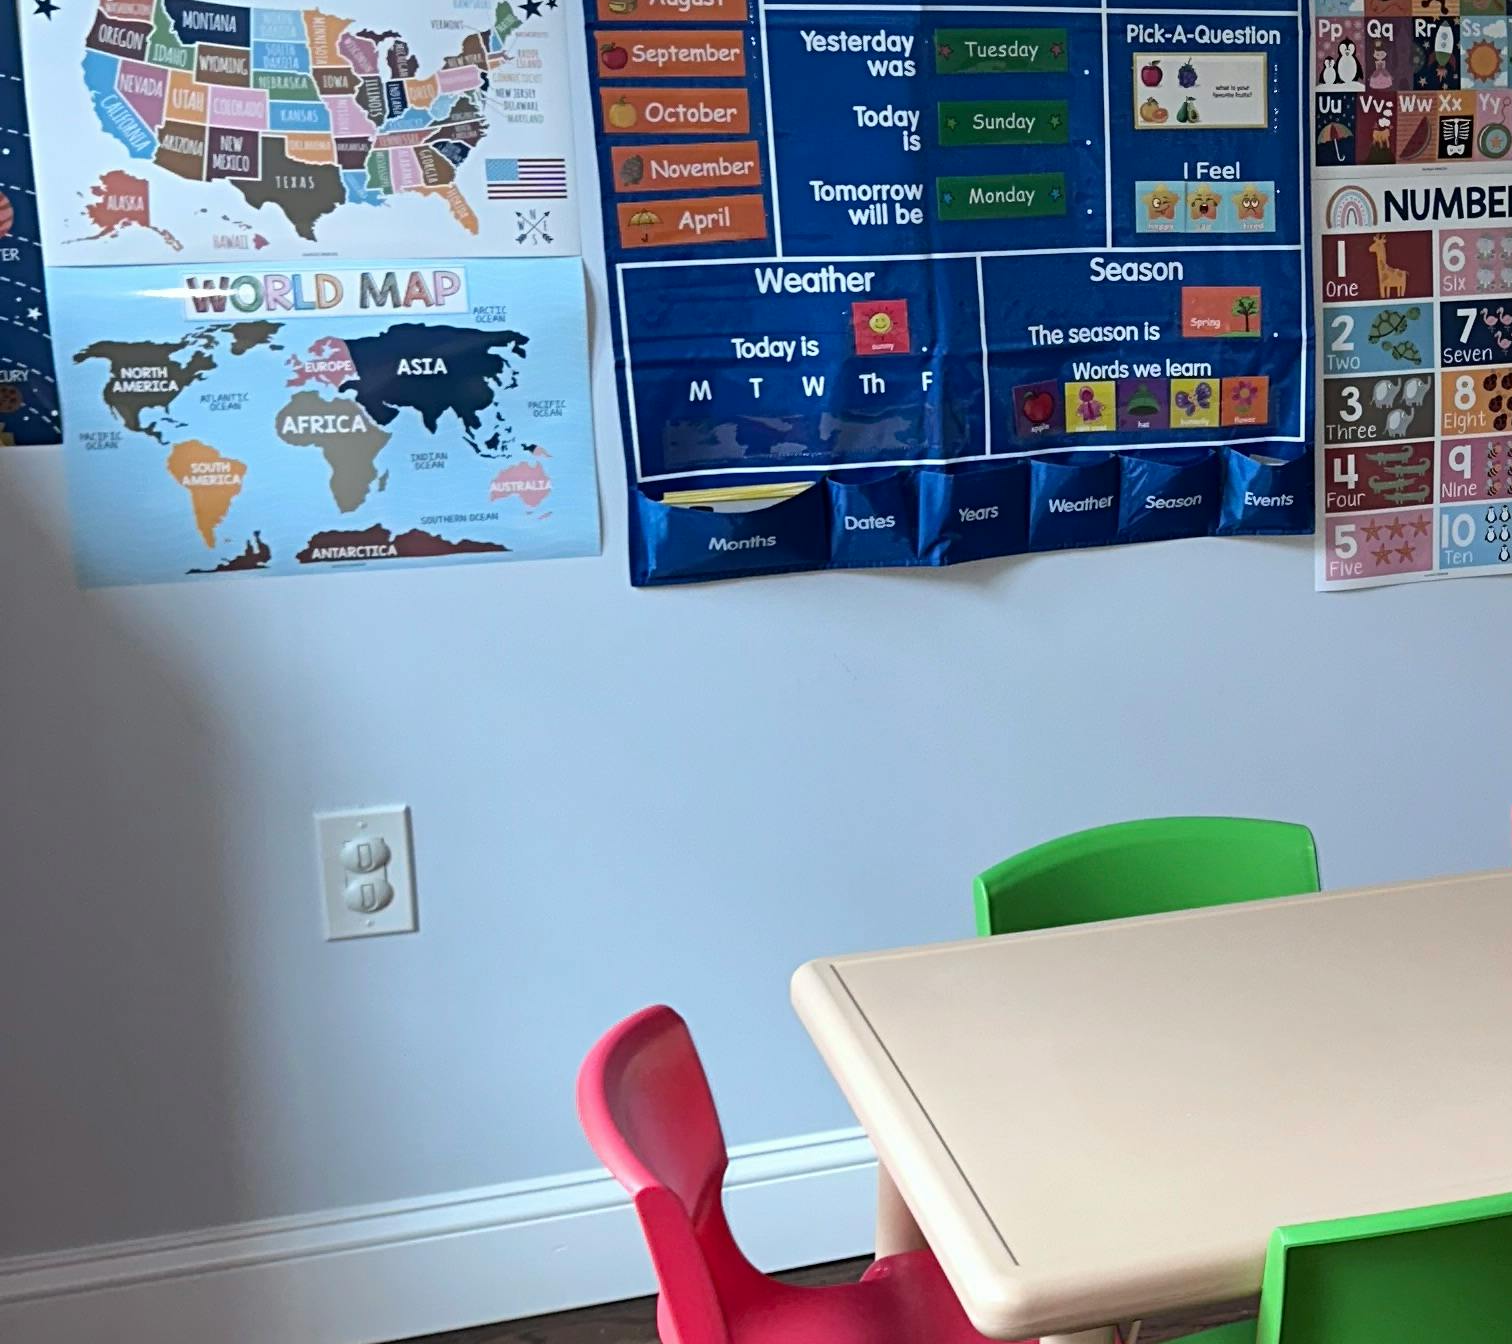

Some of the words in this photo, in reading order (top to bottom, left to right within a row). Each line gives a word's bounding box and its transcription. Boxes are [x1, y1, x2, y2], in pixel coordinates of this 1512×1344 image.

[182, 11, 237, 33] MONTANA
[98, 24, 144, 50] OREGON
[801, 29, 914, 55] Yesterday
[1126, 24, 1281, 45] Pick-A-Question
[152, 43, 188, 68] IDAHO
[631, 45, 740, 67] September
[964, 41, 1039, 61] Tuesday
[199, 54, 248, 75] WYOMING
[867, 58, 916, 77] was
[120, 73, 163, 98] NEVADA
[323, 74, 348, 88] IOWA
[172, 88, 204, 111] UTAH
[280, 109, 319, 122] KANSAS
[645, 102, 738, 124] October
[852, 105, 920, 132] Today
[972, 113, 1036, 134] Sunday
[220, 136, 242, 152] NEW
[902, 131, 921, 151] is
[213, 155, 249, 172] MEXICO
[650, 158, 754, 180] November
[1183, 162, 1188, 179] I
[1196, 161, 1241, 180] Feel
[275, 176, 315, 189] TEXAS
[809, 180, 924, 202] Tomorrow
[107, 196, 144, 211] ALASKA
[968, 188, 1035, 207] Monday
[678, 207, 731, 230] April
[848, 204, 888, 225] will
[896, 204, 924, 225] be
[1090, 257, 1183, 282] Season
[755, 265, 875, 294] Weather
[1326, 280, 1359, 297] One
[186, 273, 344, 313] WORLD
[359, 270, 461, 308] MAP
[1190, 317, 1221, 329] Spring
[1028, 326, 1064, 345] The
[1068, 323, 1140, 343] season
[1144, 322, 1160, 341] is
[731, 336, 796, 361] Today
[801, 336, 819, 356] is
[1443, 348, 1493, 364] Seven
[120, 366, 169, 380] NORTH
[304, 359, 353, 373] EUROPE
[397, 357, 448, 376] ASIA
[1072, 360, 1129, 380] Words
[1133, 363, 1161, 377] we
[1166, 359, 1212, 377] learn
[112, 379, 180, 393] AMERICA
[689, 380, 712, 401] M
[749, 377, 764, 399] T
[802, 375, 825, 397] W
[859, 372, 886, 394] Th
[921, 371, 933, 392] F
[282, 415, 367, 435] AFRICA
[1326, 424, 1376, 440] Three
[190, 462, 232, 475] SOUTH
[182, 474, 241, 487] AMERICA
[489, 479, 553, 494] AUSTRALIA
[1049, 493, 1113, 513] Weather
[1145, 493, 1202, 510] Season
[1244, 492, 1294, 507] Events
[1327, 492, 1365, 508] Four
[844, 514, 895, 530] Dates
[958, 505, 999, 522] Years
[311, 544, 398, 560] ANTARCTICA
[708, 535, 777, 551] Months
